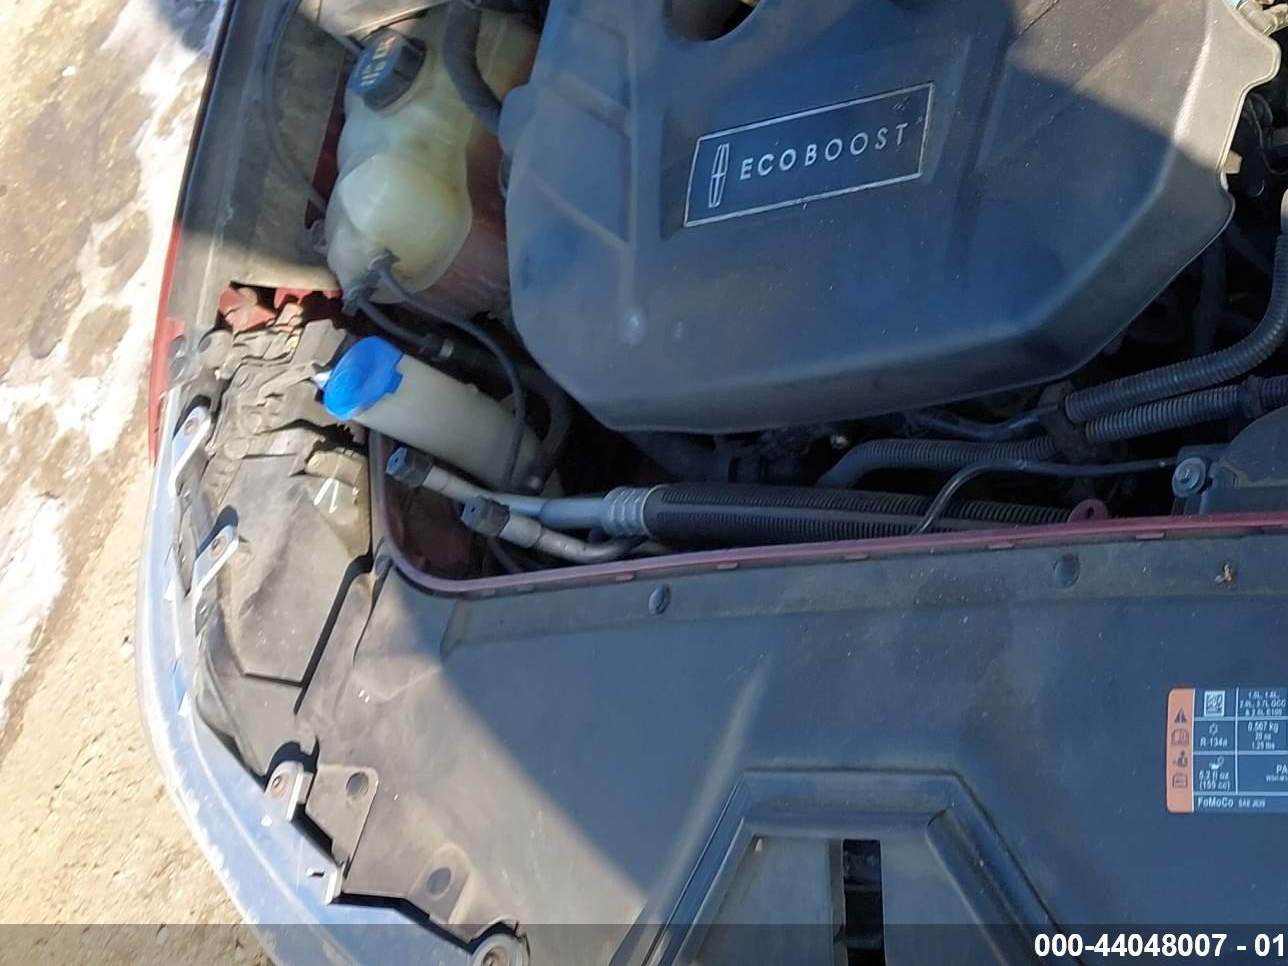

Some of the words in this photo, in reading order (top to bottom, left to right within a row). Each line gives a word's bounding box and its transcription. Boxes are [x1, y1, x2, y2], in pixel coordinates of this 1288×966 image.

[739, 122, 909, 181] ECOBOOST
[1269, 721, 1279, 733] kg
[1200, 736, 1228, 747] R-134a
[1197, 796, 1234, 808] FoMoCo
